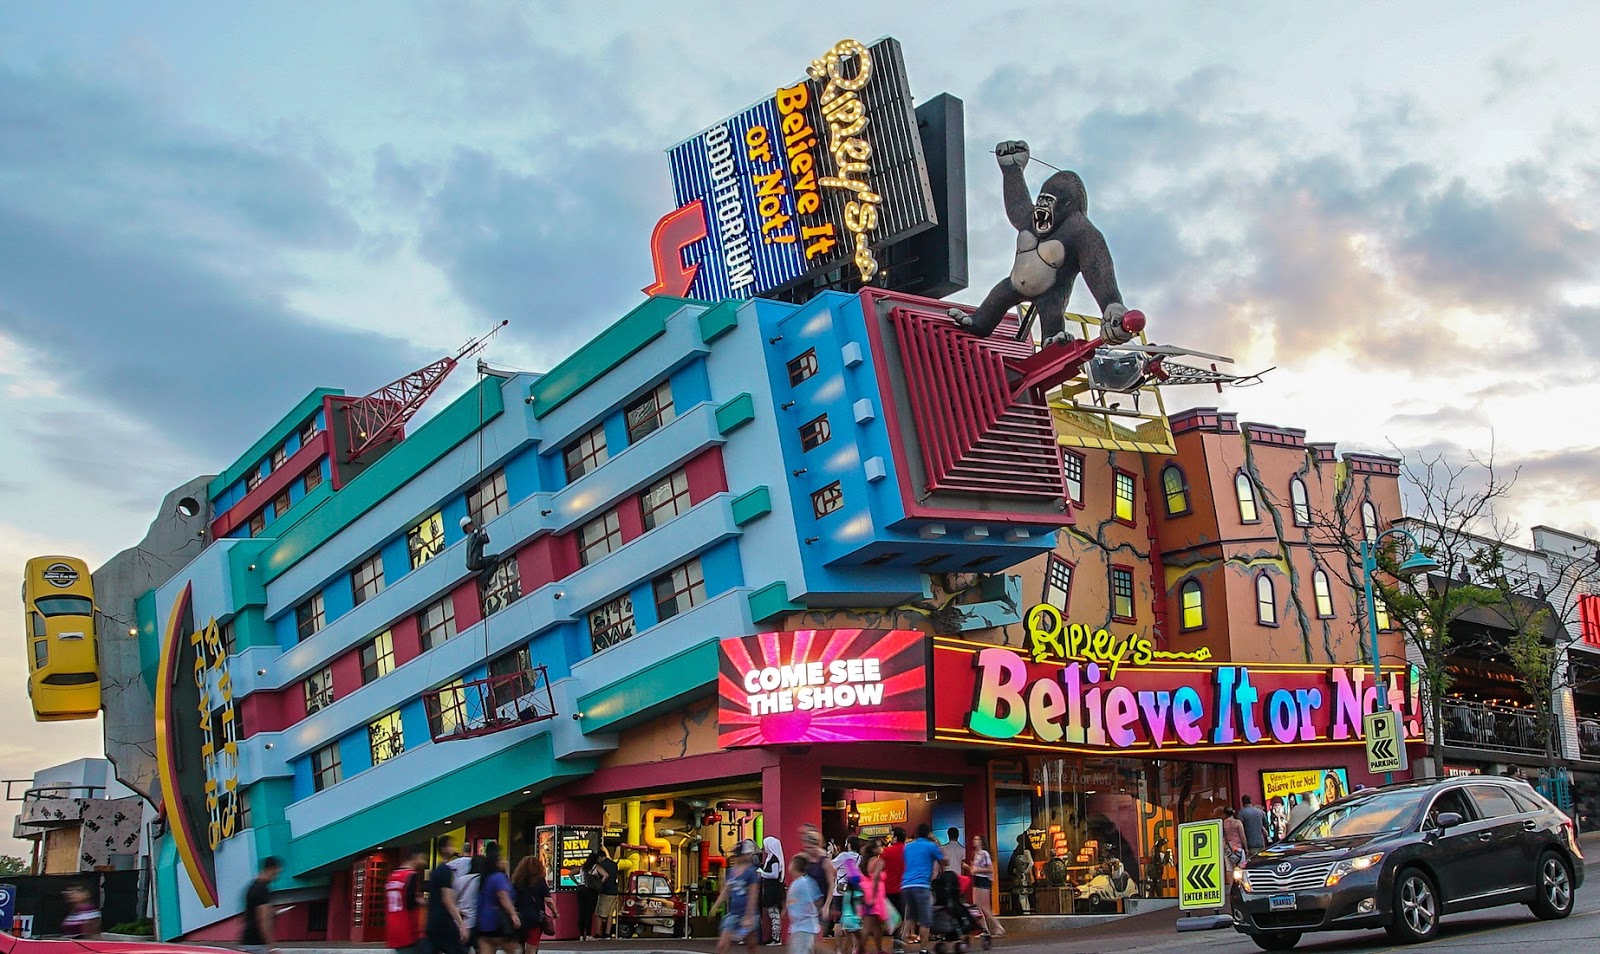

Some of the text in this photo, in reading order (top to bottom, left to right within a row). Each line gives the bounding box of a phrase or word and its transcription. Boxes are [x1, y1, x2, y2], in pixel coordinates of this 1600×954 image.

[746, 125, 797, 245] or Not!
[776, 83, 836, 261] Believe It
[705, 125, 755, 291] ODDITORIUM
[1027, 603, 1152, 681] Ripley's
[744, 658, 881, 693] COME SEE
[747, 683, 884, 716] THE SHOW
[969, 647, 1204, 748] Believe
[1214, 667, 1262, 744] It
[1270, 688, 1322, 743] or
[191, 629, 221, 851] TOWERS
[1374, 719, 1386, 737] P
[1370, 758, 1399, 769] PARKING
[563, 840, 590, 850] NEW
[1193, 832, 1208, 857] P
[1184, 890, 1220, 902] ENTER HERE
